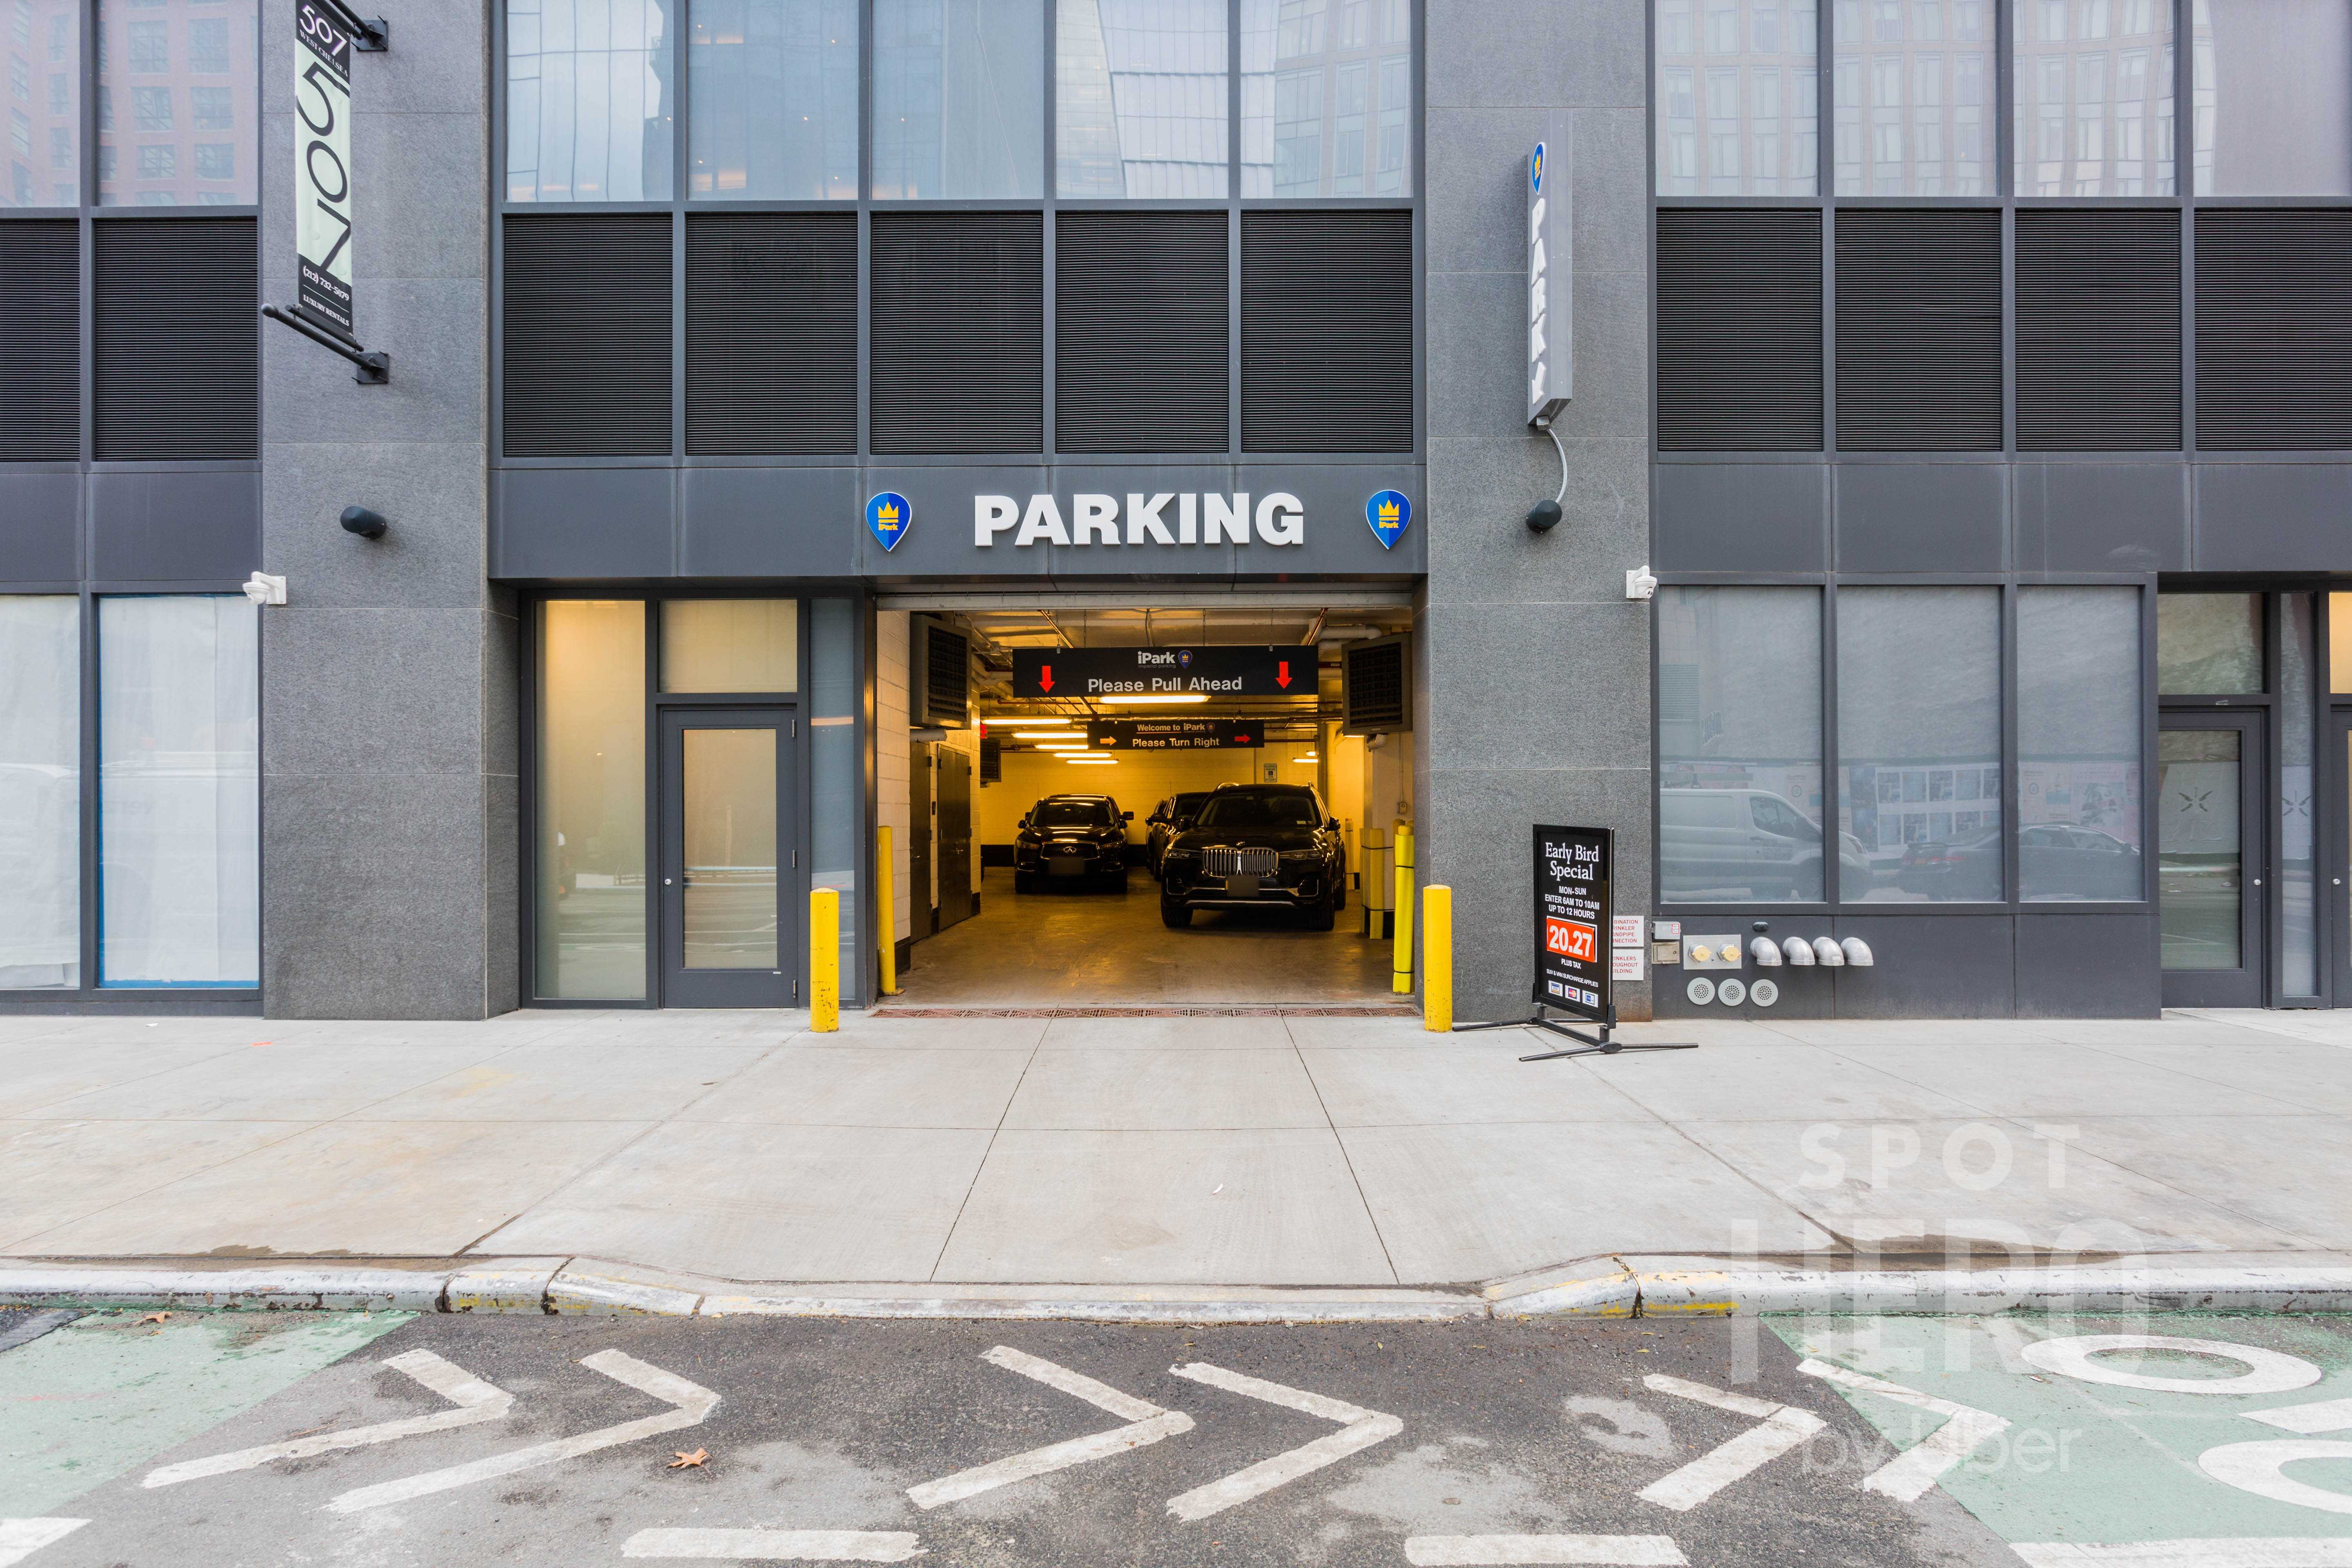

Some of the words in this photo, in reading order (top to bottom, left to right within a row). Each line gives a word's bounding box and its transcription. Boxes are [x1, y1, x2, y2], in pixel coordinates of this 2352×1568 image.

[299, 4, 347, 56] 507
[300, 29, 318, 50] WEST
[318, 47, 348, 77] CHELSEA
[303, 265, 318, 284] (212)
[303, 294, 325, 312] LUXURY
[325, 308, 349, 326] RENTALS
[975, 492, 1303, 546] PARKING
[1138, 651, 1176, 664] iPark
[1089, 678, 1144, 693] Please
[1152, 678, 1181, 691] Pull
[1189, 677, 1242, 690] Ahead
[1132, 738, 1165, 747] Please
[1194, 738, 1219, 747] Right
[1545, 842, 1572, 864] Early
[1575, 844, 1599, 862] Bird
[1550, 860, 1594, 881] Special
[1545, 894, 1562, 904] ENTER
[1563, 897, 1574, 906] 6AM
[1584, 900, 1600, 910] 10AM
[1548, 904, 1557, 912] UP
[1557, 906, 1565, 914] TO
[1566, 907, 1572, 915] 12
[1573, 909, 1595, 920] HOURS
[1549, 925, 1592, 957] 20.27
[1561, 958, 1572, 968] PLUS
[1572, 960, 1581, 969] TAX
[1563, 973, 1584, 984] SURCHARGE
[1583, 979, 1599, 988] APPLIES
